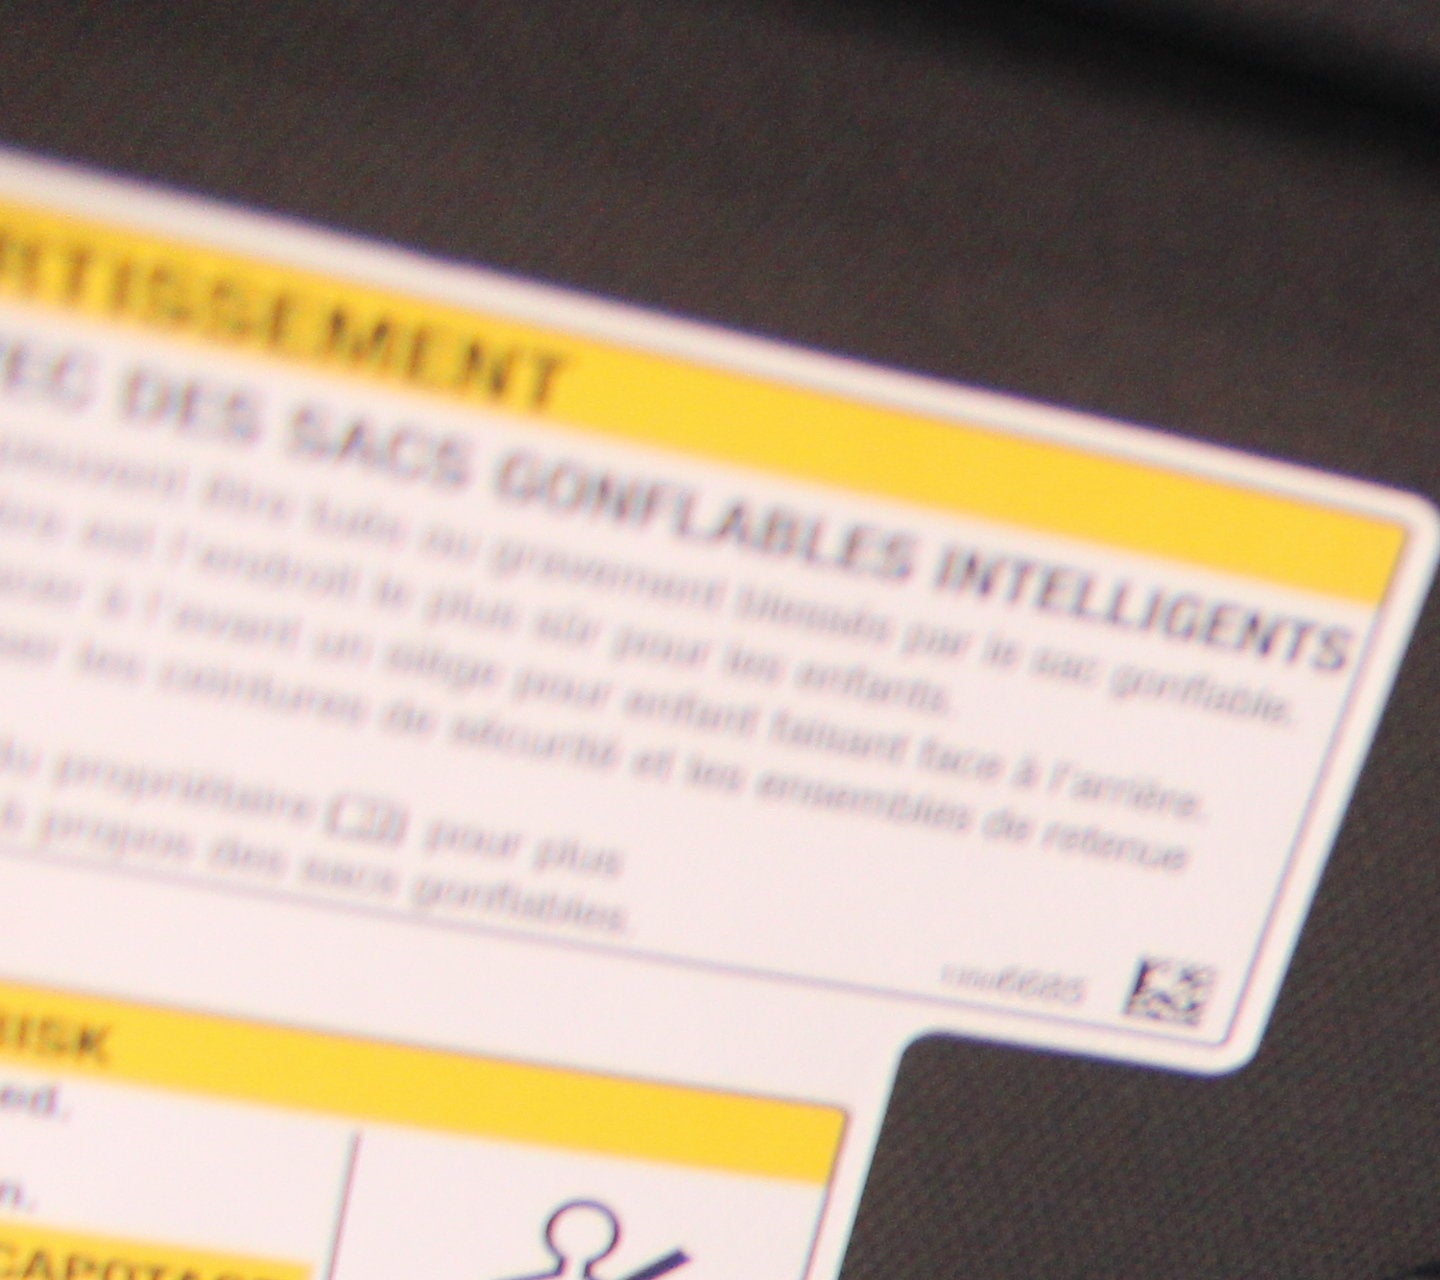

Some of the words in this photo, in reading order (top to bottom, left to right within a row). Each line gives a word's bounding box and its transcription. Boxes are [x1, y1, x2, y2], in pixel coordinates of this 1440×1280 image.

[0, 335, 94, 412] EC
[118, 364, 262, 446] DES
[286, 398, 476, 490] SACS
[491, 446, 918, 588] GONFLABLES
[935, 541, 1358, 676] INTELLIGENTS
[0, 1012, 112, 1066] ISK
